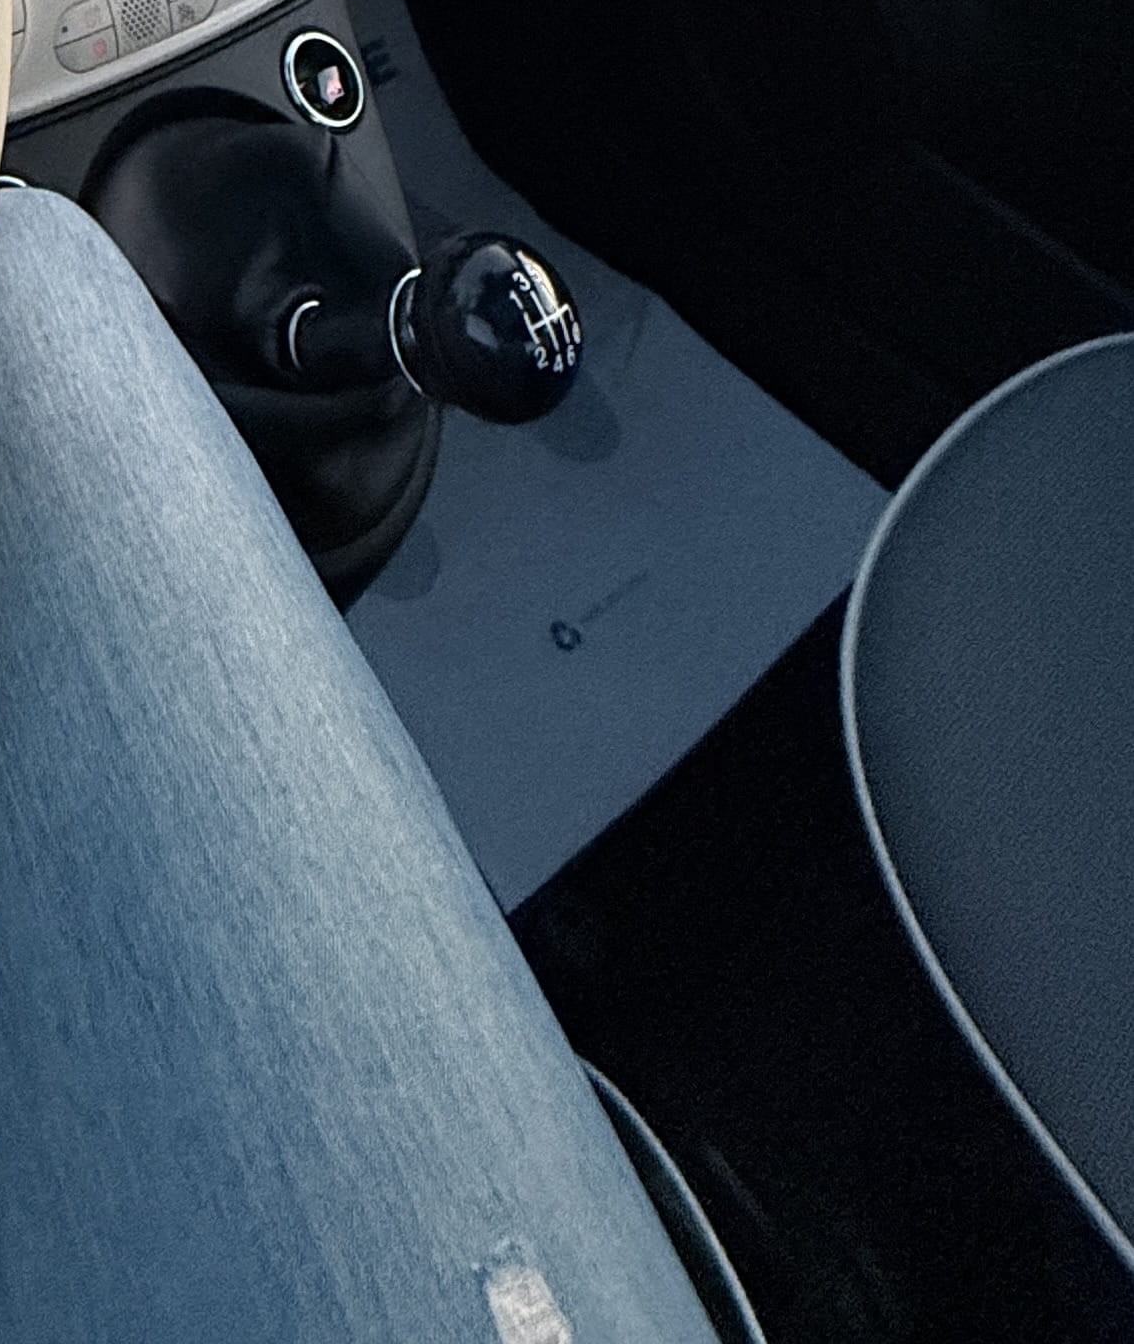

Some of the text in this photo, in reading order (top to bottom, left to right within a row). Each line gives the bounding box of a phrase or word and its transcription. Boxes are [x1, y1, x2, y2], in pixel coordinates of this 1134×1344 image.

[512, 271, 531, 292] 3
[534, 346, 549, 369] 2
[553, 353, 564, 373] 4
